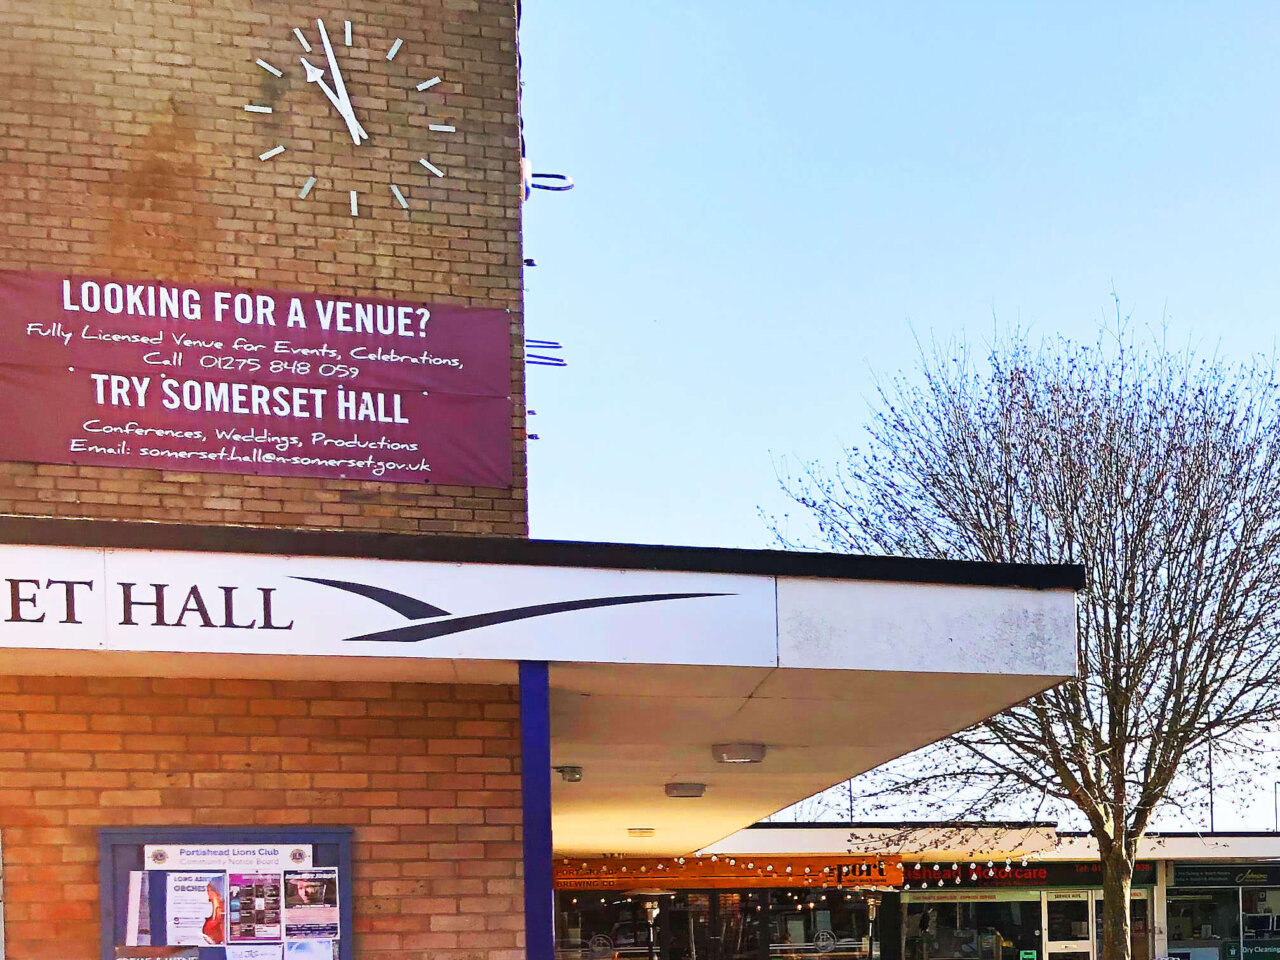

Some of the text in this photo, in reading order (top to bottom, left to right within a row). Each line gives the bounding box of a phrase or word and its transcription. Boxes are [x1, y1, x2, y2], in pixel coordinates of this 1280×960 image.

[62, 279, 431, 338] LOOKING FOR A VENUE?
[26, 322, 465, 370] Fully Licensed Venue for Events, Celebrations,
[143, 352, 360, 378] Call 01275 848 059
[91, 373, 410, 424] TRY SOMERSET HALL
[70, 438, 131, 456] Email:
[83, 419, 419, 452] Conferences, Weddings, Productions
[4, 577, 295, 631] ET HALL
[179, 848, 280, 856] Portishead Lions Club
[836, 860, 886, 886] port
[970, 865, 1048, 880] Motorcare
